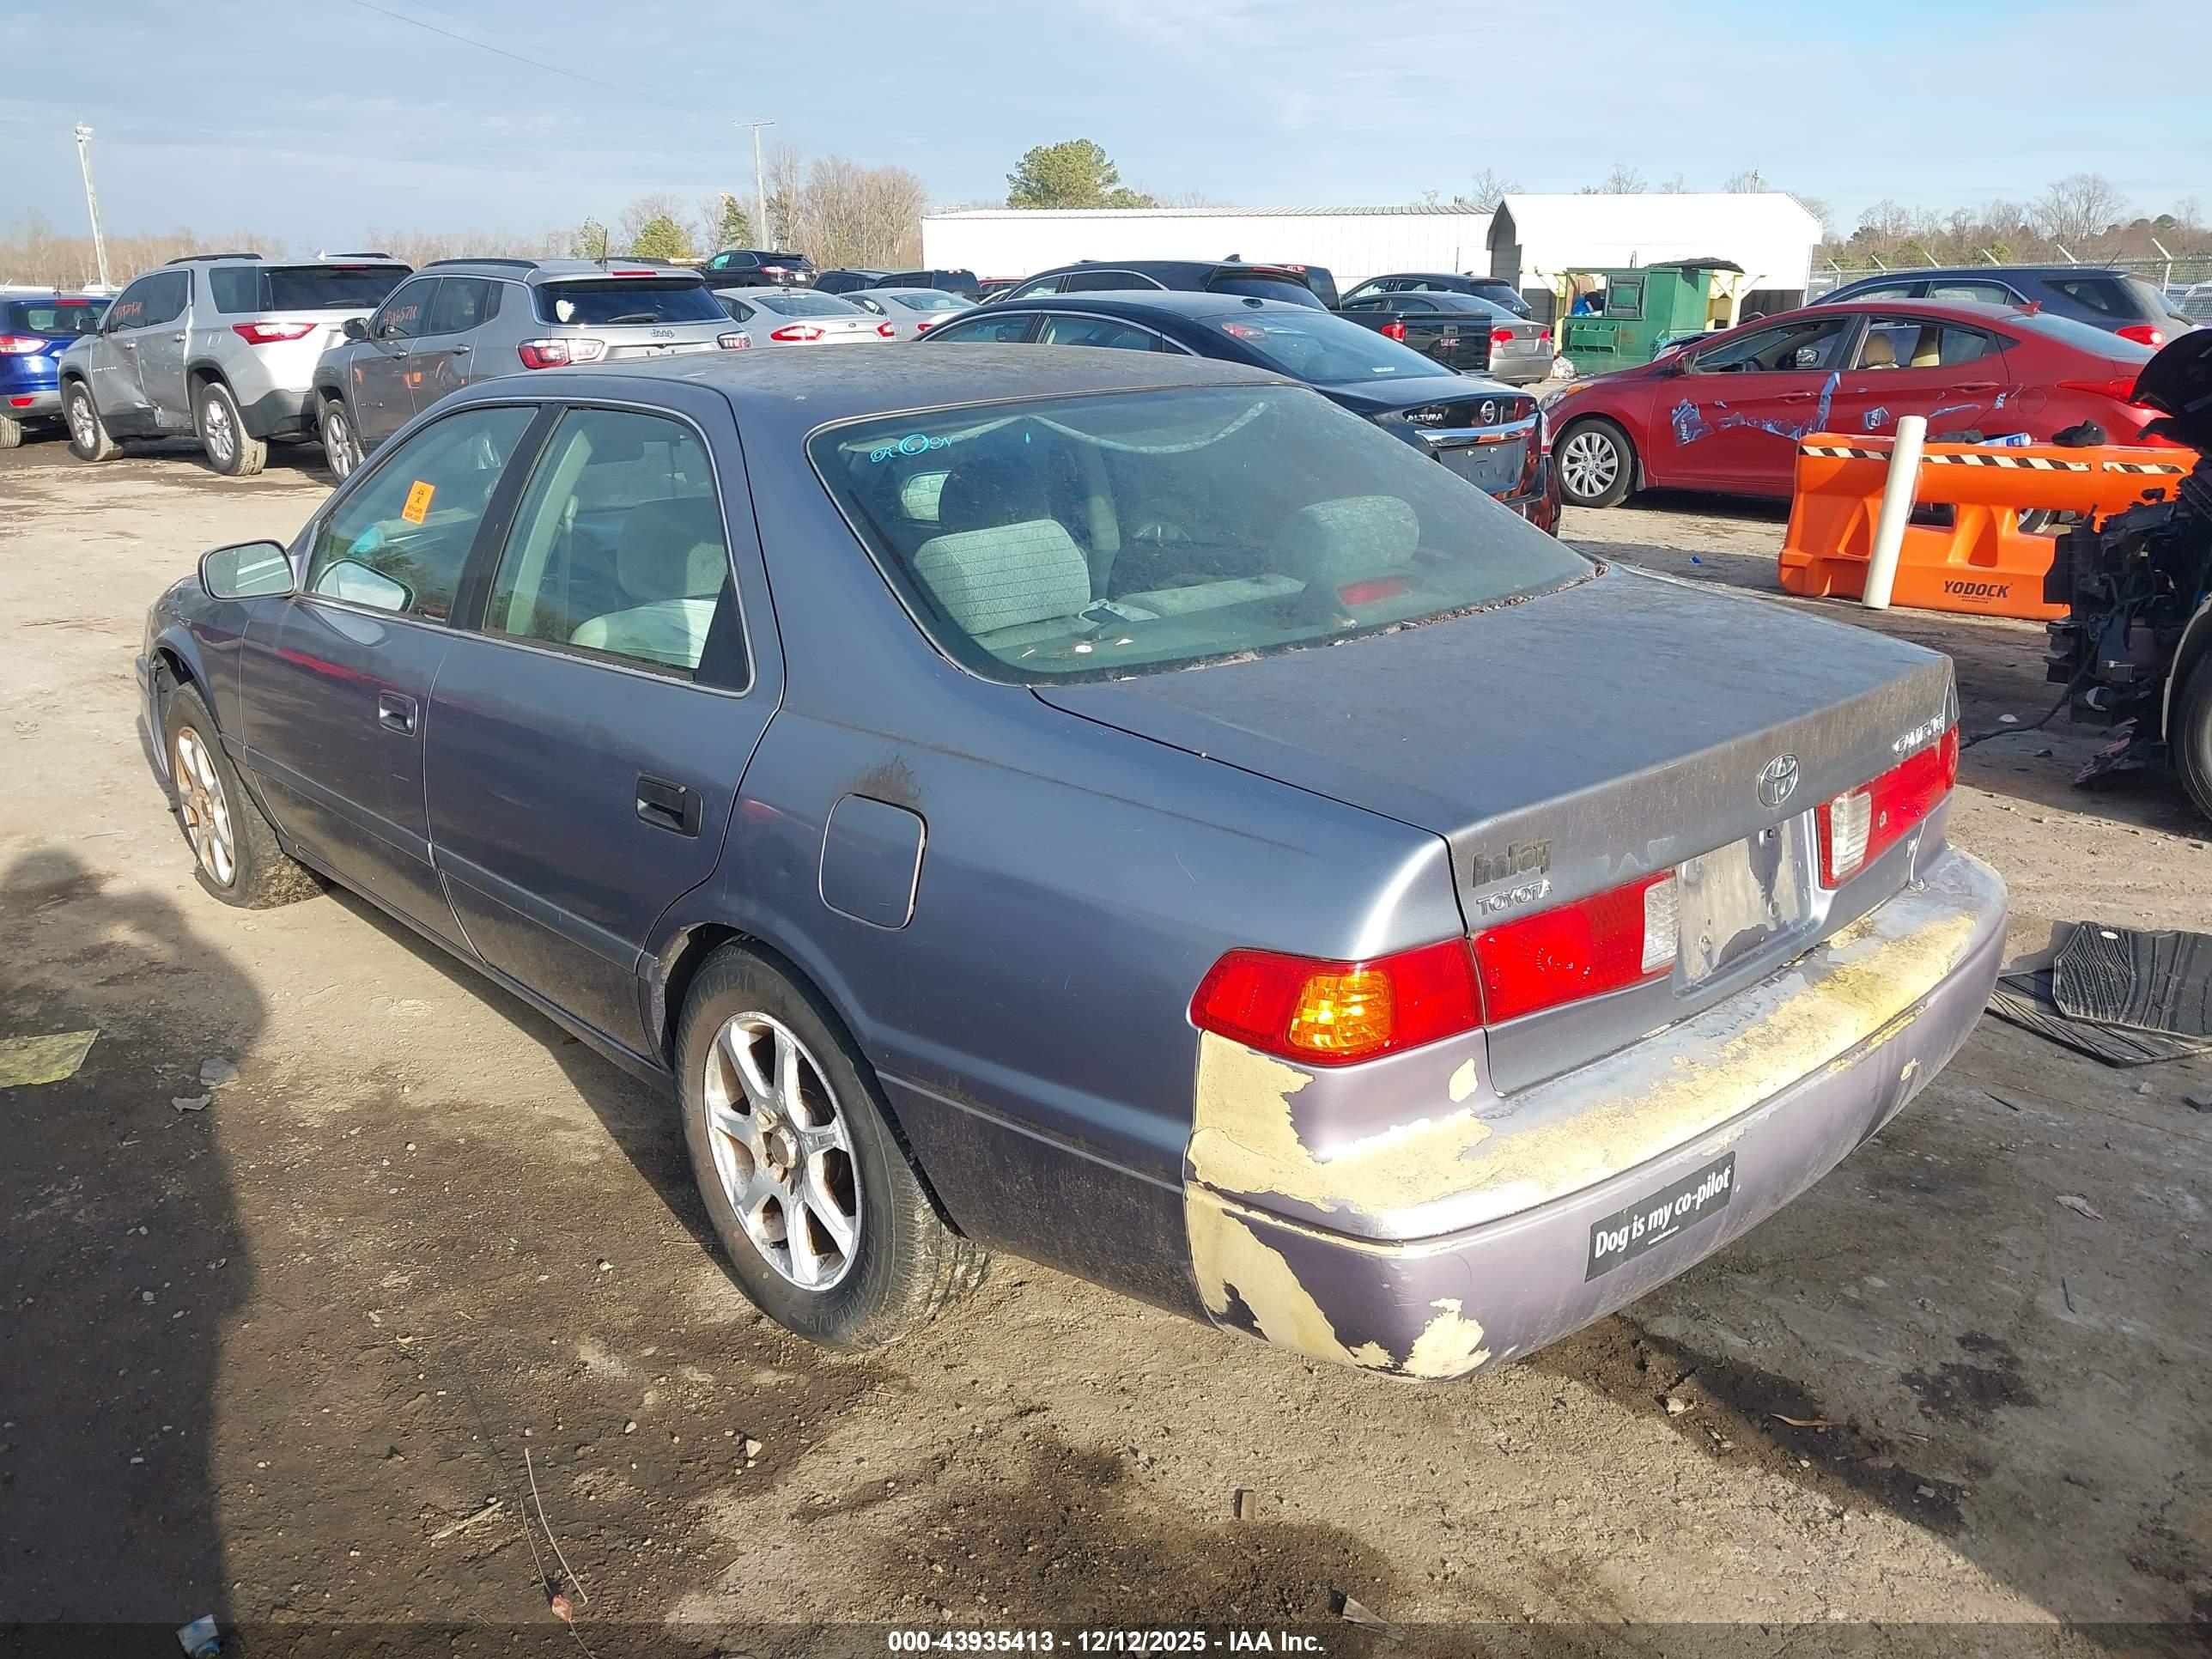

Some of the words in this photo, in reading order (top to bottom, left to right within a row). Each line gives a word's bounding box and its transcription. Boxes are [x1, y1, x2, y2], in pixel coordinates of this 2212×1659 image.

[1944, 580, 2009, 599] YODOCK
[1476, 879, 1553, 916] TOYOTA
[1595, 1225, 1629, 1259] Dog
[1632, 1214, 1645, 1240] is
[1647, 1202, 1673, 1230] my
[1674, 1166, 1731, 1215] co-pilot
